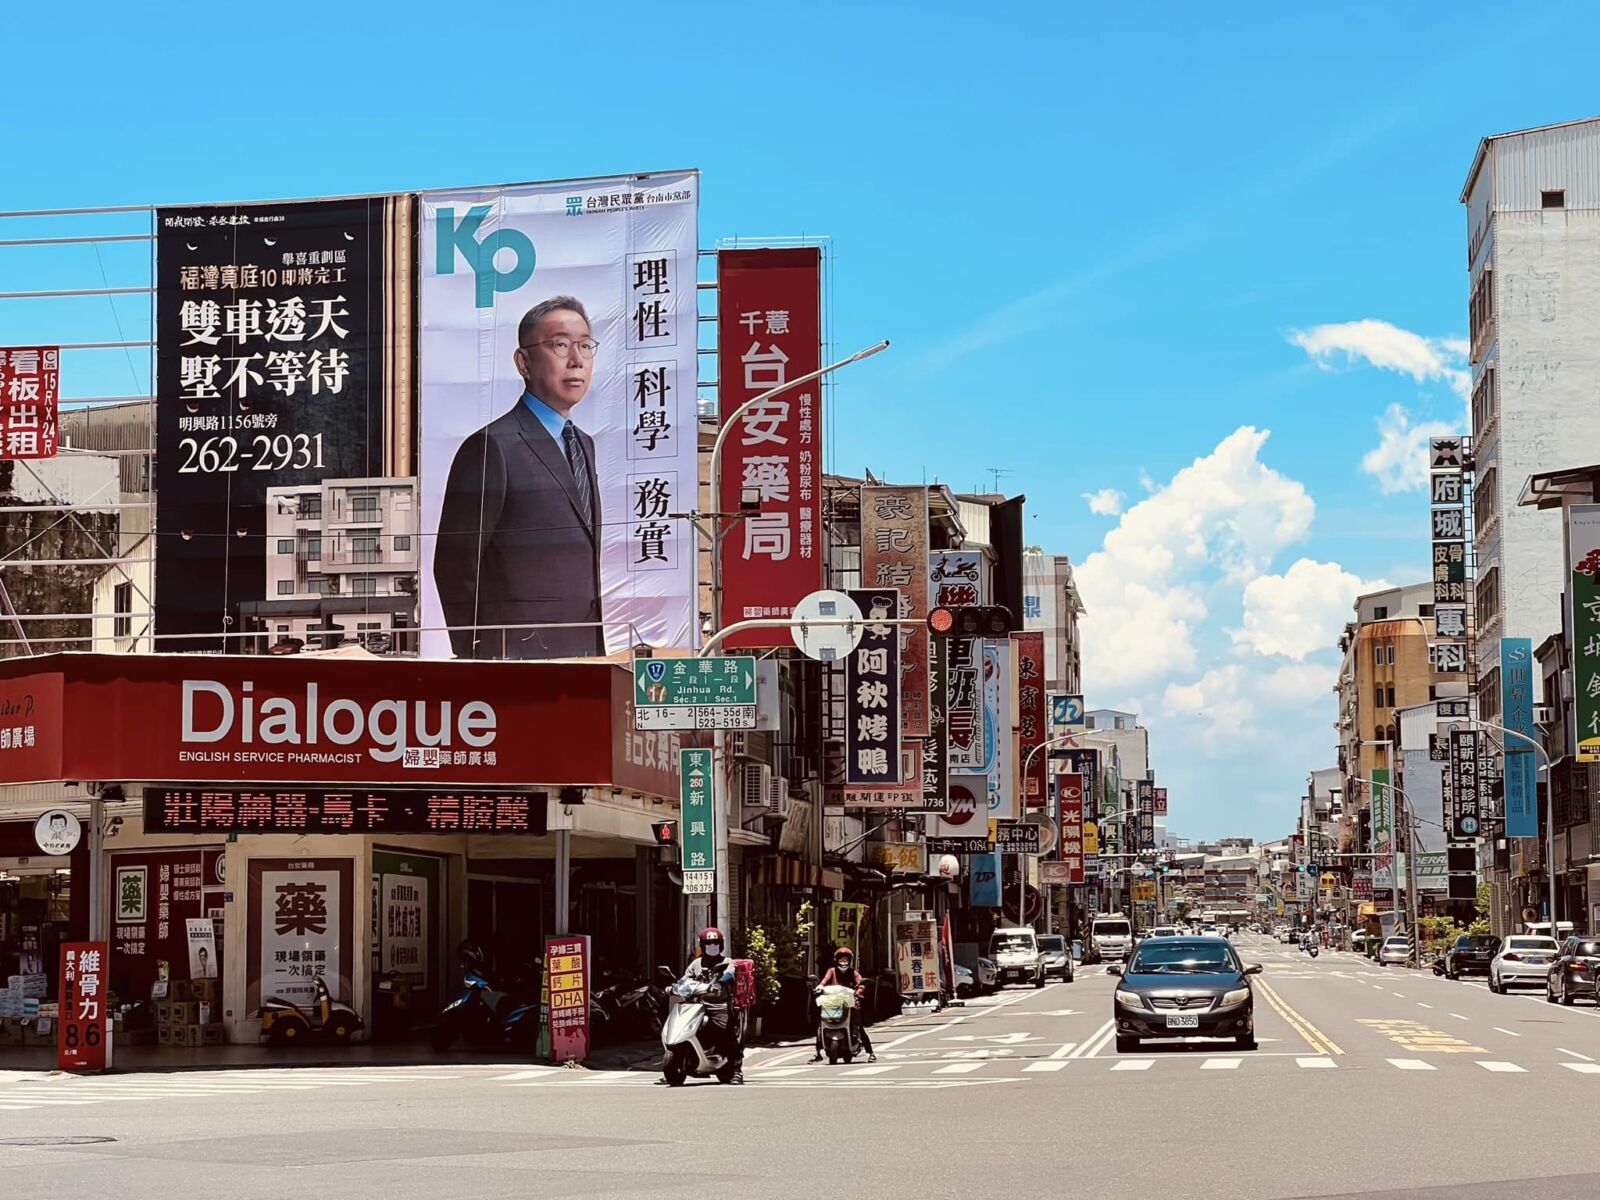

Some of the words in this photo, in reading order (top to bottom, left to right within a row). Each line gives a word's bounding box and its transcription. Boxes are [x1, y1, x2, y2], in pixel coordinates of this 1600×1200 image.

[586, 193, 645, 208] 台灣民眾黨
[281, 266, 347, 288] 即將完工
[633, 257, 670, 341] 理性
[179, 295, 350, 347] 雙車透天
[179, 348, 350, 399] 墅不等待
[7, 350, 40, 456] 看板出租
[179, 413, 278, 432] 明興路1156號旁
[633, 366, 671, 452] 科學
[799, 393, 812, 444] 慢性處方
[178, 432, 326, 474] 262-2931
[741, 341, 791, 561] 台安藥局
[799, 450, 812, 501] 奶粉尿布
[633, 478, 672, 563] 務實
[1434, 475, 1461, 536] 府城
[799, 507, 812, 559] 醫療器材
[1434, 545, 1449, 601] 皮膚科
[1437, 609, 1465, 672] 專科
[673, 660, 738, 675] 金華路
[677, 686, 711, 694] Jinhua
[720, 686, 735, 694] Rd.
[182, 680, 497, 761] Dialogue
[637, 709, 650, 720] 北
[743, 707, 754, 719] 南
[698, 718, 741, 728] 523-519
[857, 648, 888, 775] 阿秋烤鴨
[179, 751, 230, 762] ENGLISH
[234, 752, 285, 763] SERVICE
[288, 752, 362, 765] PHARMACIST
[403, 747, 497, 768] 婦嬰藥師廣場
[689, 752, 703, 767] 東
[690, 778, 703, 788] 260
[1459, 733, 1476, 815] 頤新內科診所
[690, 790, 706, 867] 新興路
[1062, 809, 1081, 869] 光陽機車
[122, 875, 141, 913] 藥
[700, 873, 713, 881] 151
[700, 884, 713, 892] 375
[275, 883, 327, 936] 藥
[275, 950, 326, 962] 現場領藥
[275, 965, 326, 976] 一次搞定
[553, 974, 582, 988] 鈣片
[79, 950, 100, 1020] 維骨力
[554, 991, 583, 1007] DHA
